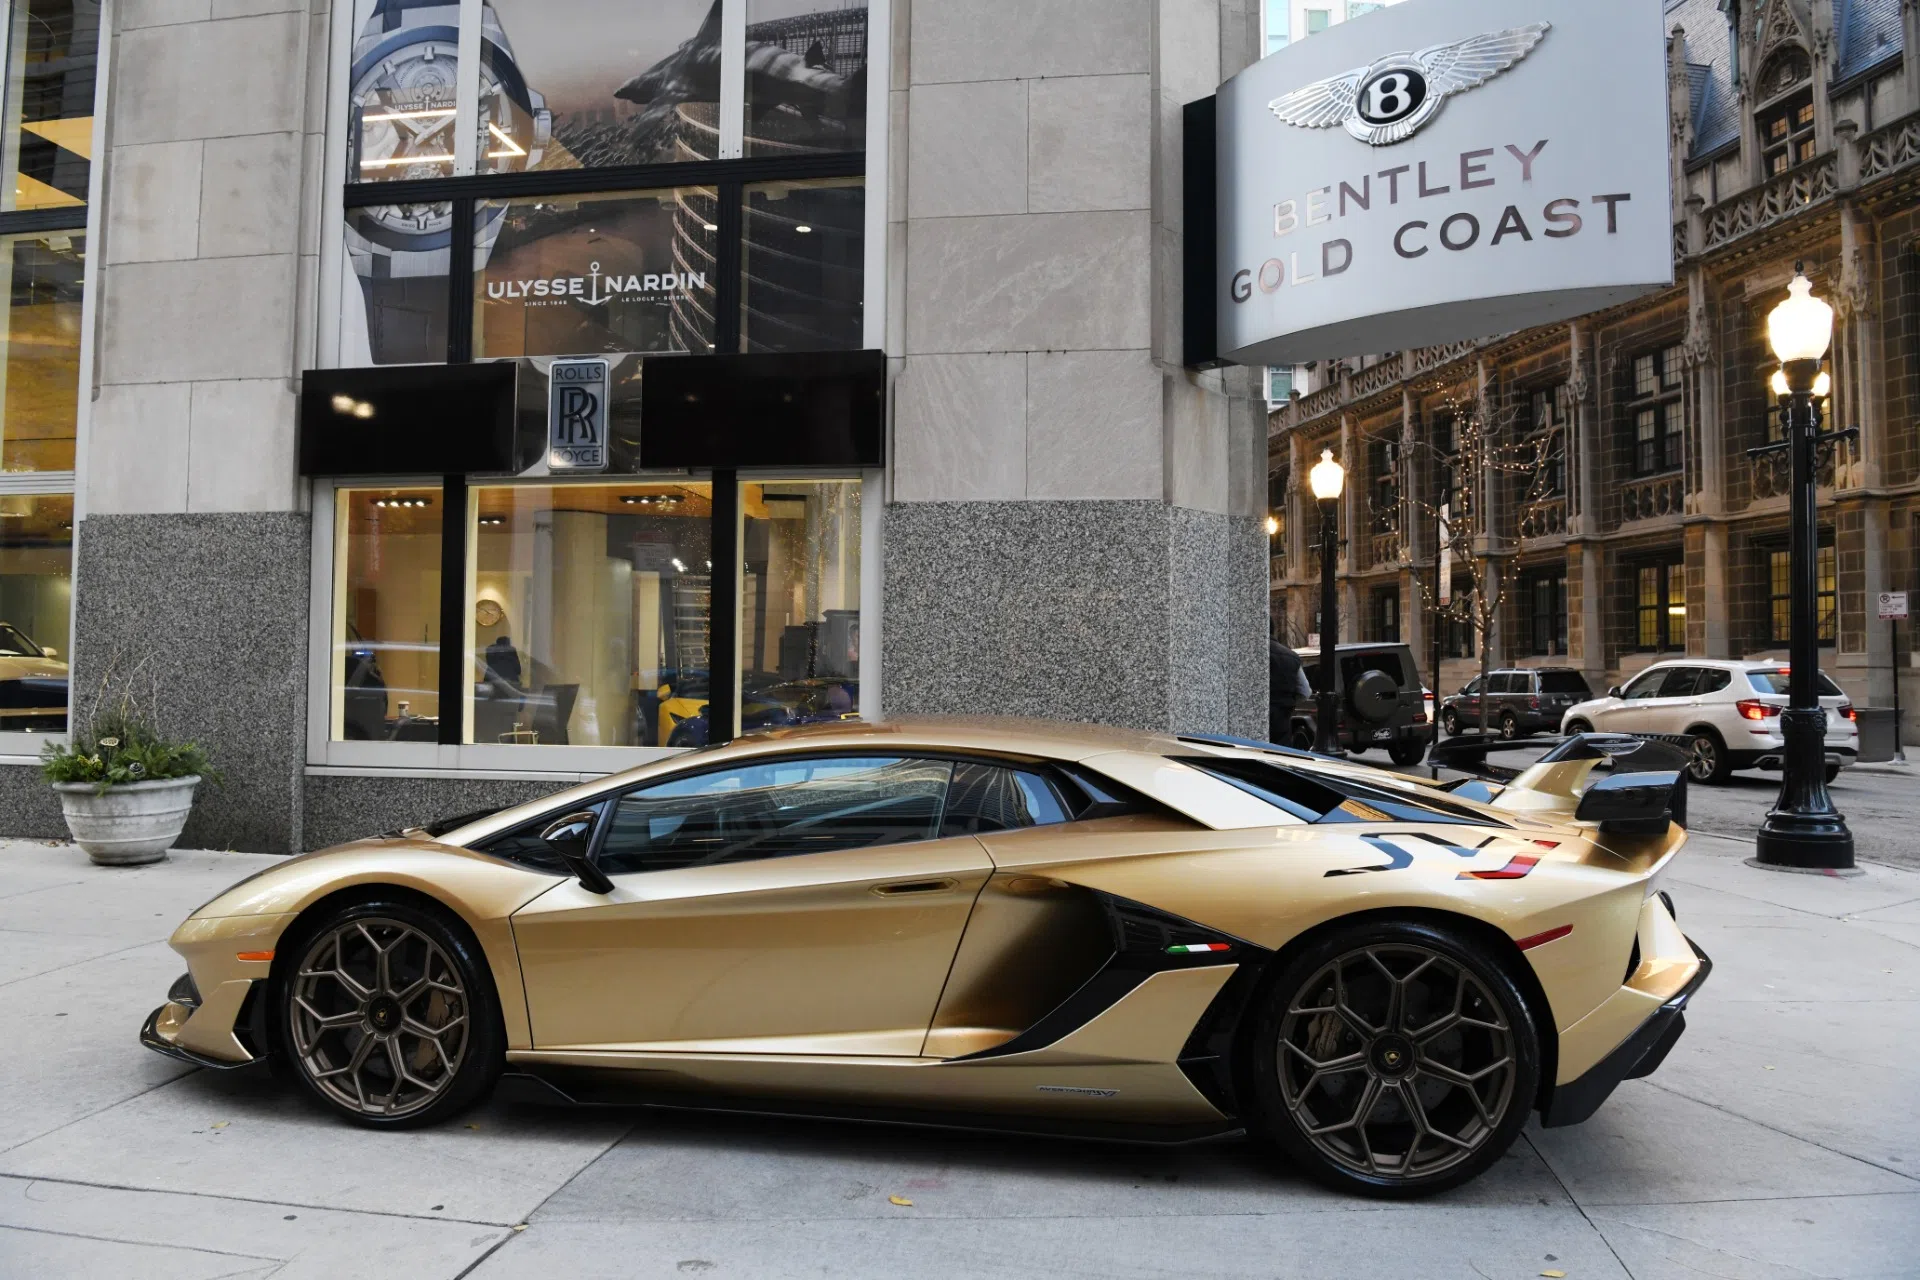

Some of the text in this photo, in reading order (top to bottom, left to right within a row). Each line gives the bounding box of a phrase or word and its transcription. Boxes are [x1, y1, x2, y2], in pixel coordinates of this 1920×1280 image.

[394, 103, 424, 111] ULYSSE
[1368, 73, 1412, 118] B
[1273, 139, 1549, 238] BENTLEY
[1230, 192, 1631, 304] GOLD COAST
[487, 272, 706, 299] ULYSSE NARDIN
[555, 366, 601, 380] ROLLS
